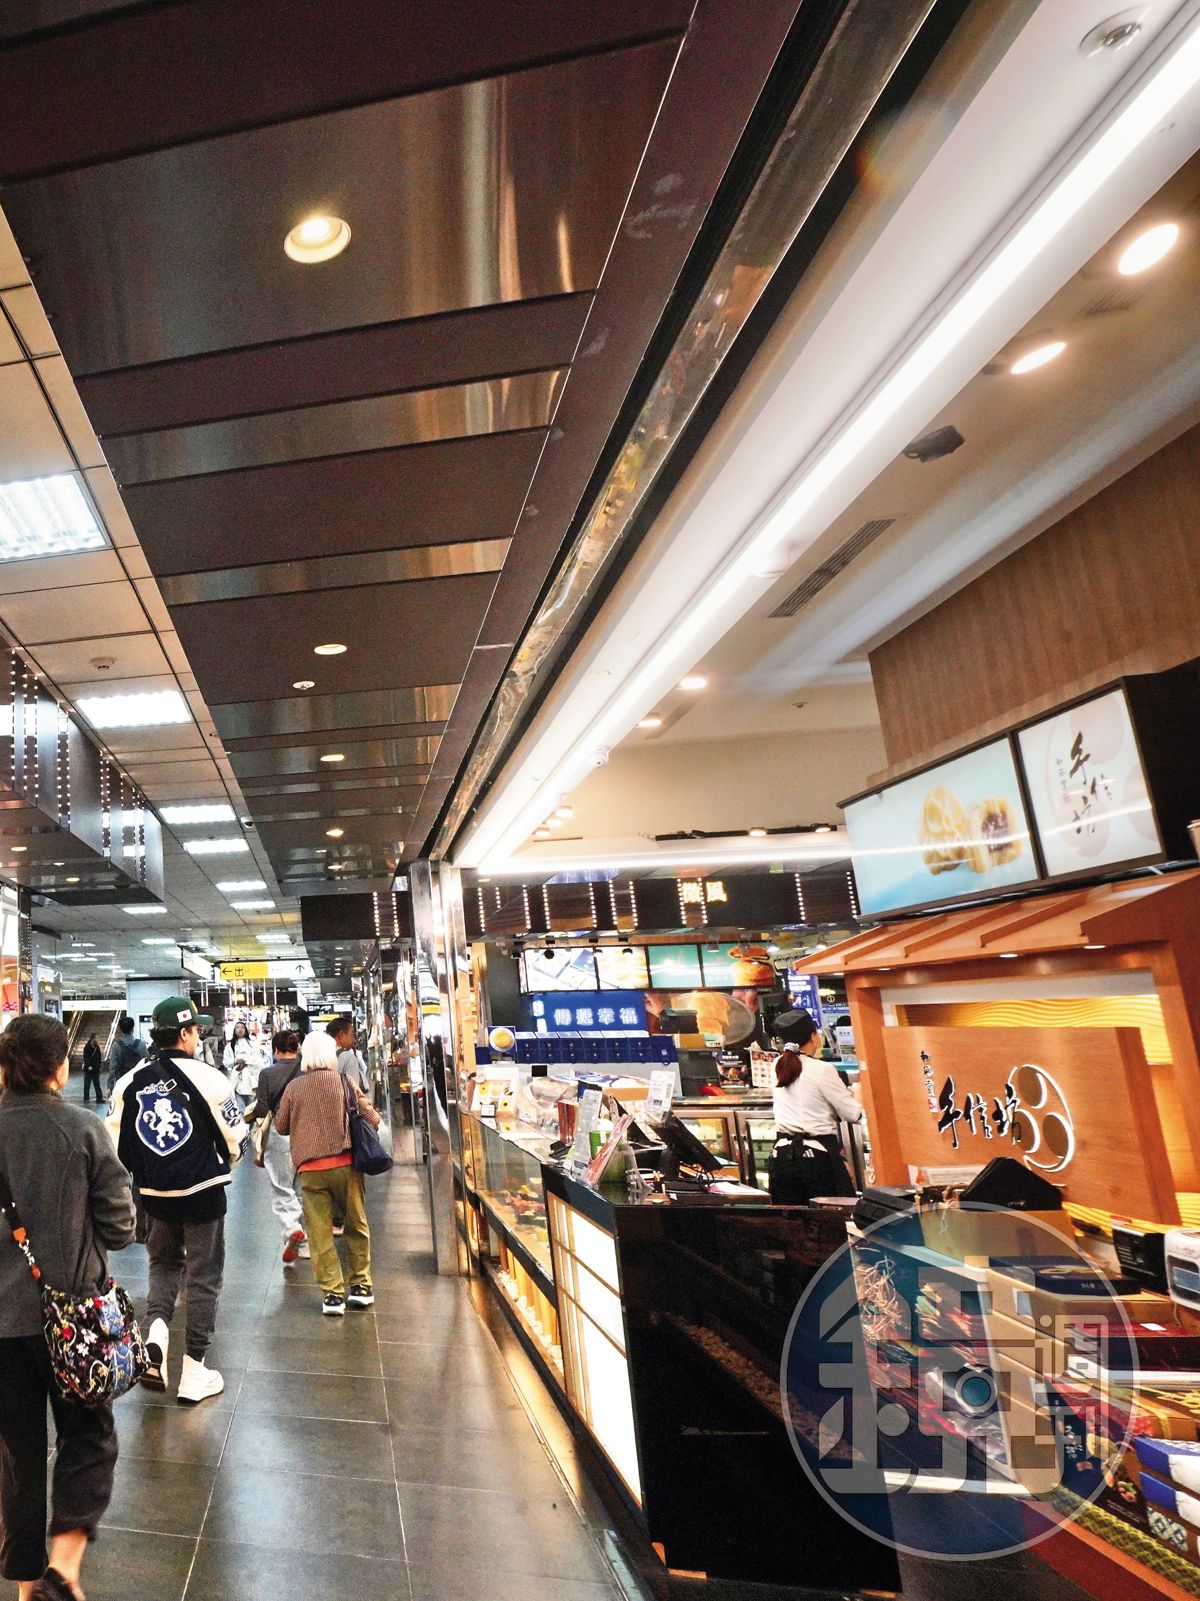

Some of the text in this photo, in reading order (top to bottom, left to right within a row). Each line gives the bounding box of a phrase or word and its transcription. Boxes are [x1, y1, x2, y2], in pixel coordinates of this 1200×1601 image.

[554, 1007, 639, 1026] 傳遞幸福
[938, 1075, 1022, 1149] 手信坊
